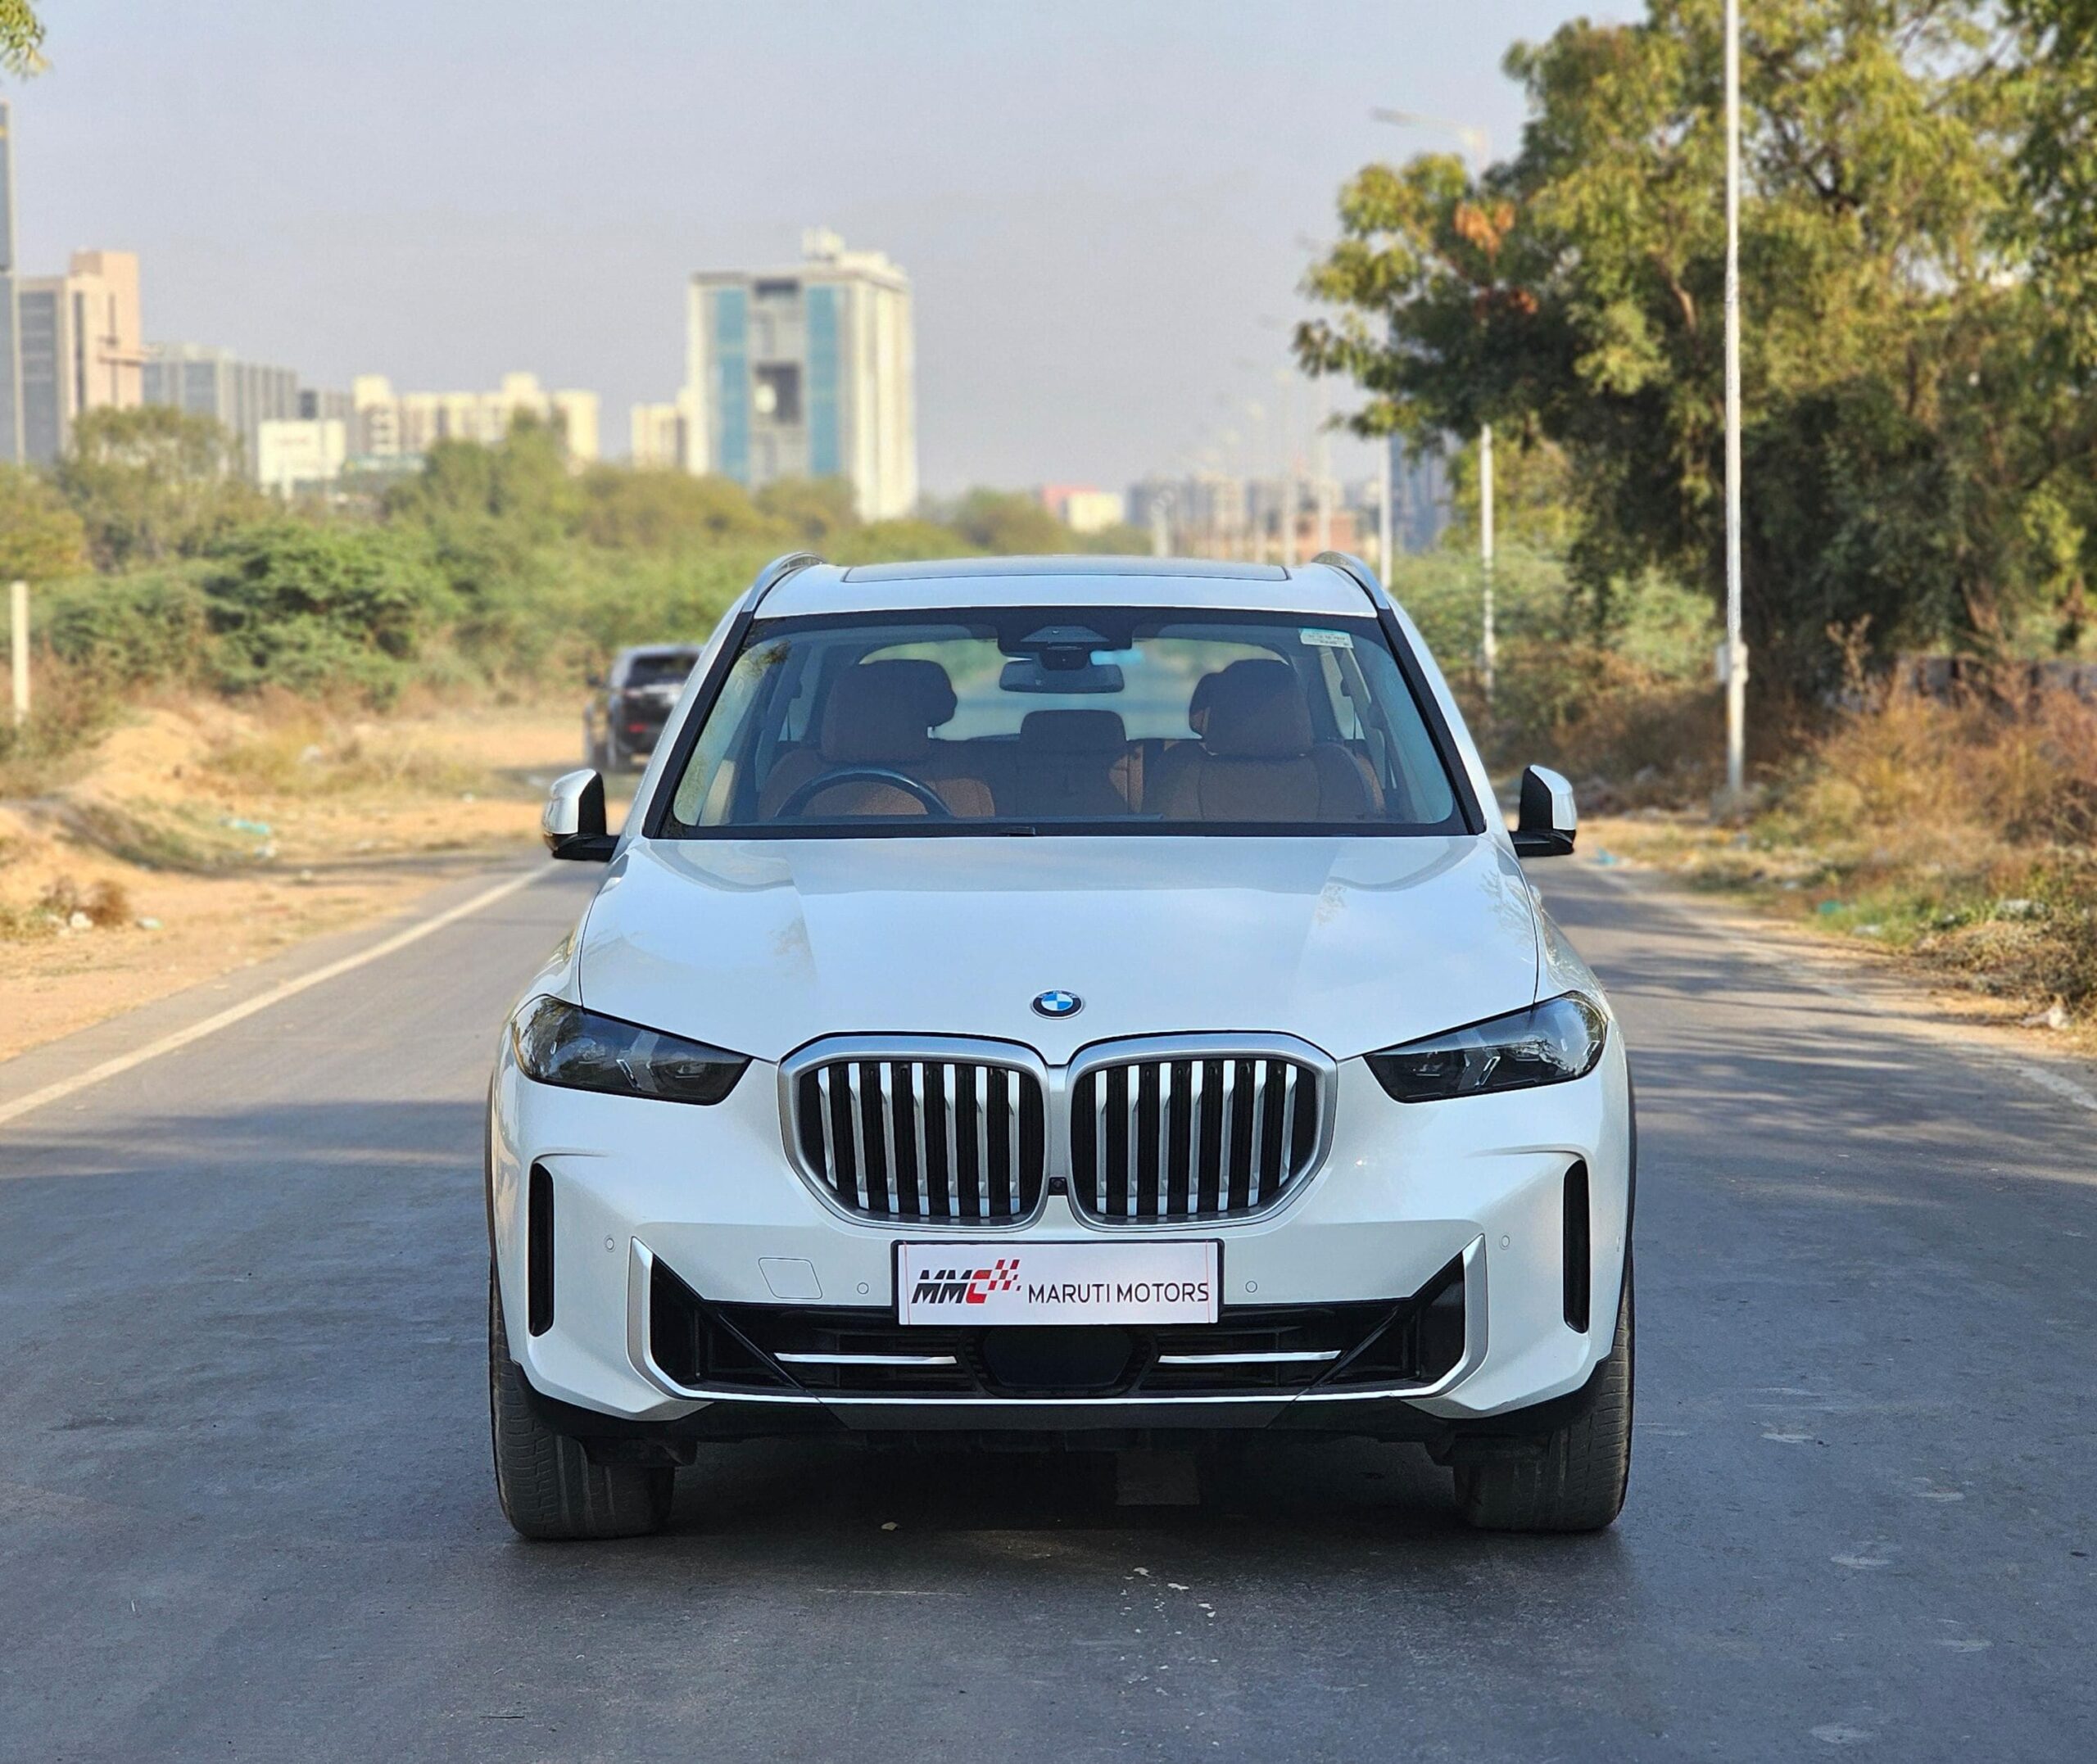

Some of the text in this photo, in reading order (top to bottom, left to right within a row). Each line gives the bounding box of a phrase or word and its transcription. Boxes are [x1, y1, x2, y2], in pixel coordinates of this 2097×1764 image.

[911, 1269, 993, 1304] MMC
[1028, 1282, 1209, 1304] MARUTI MOTORS
